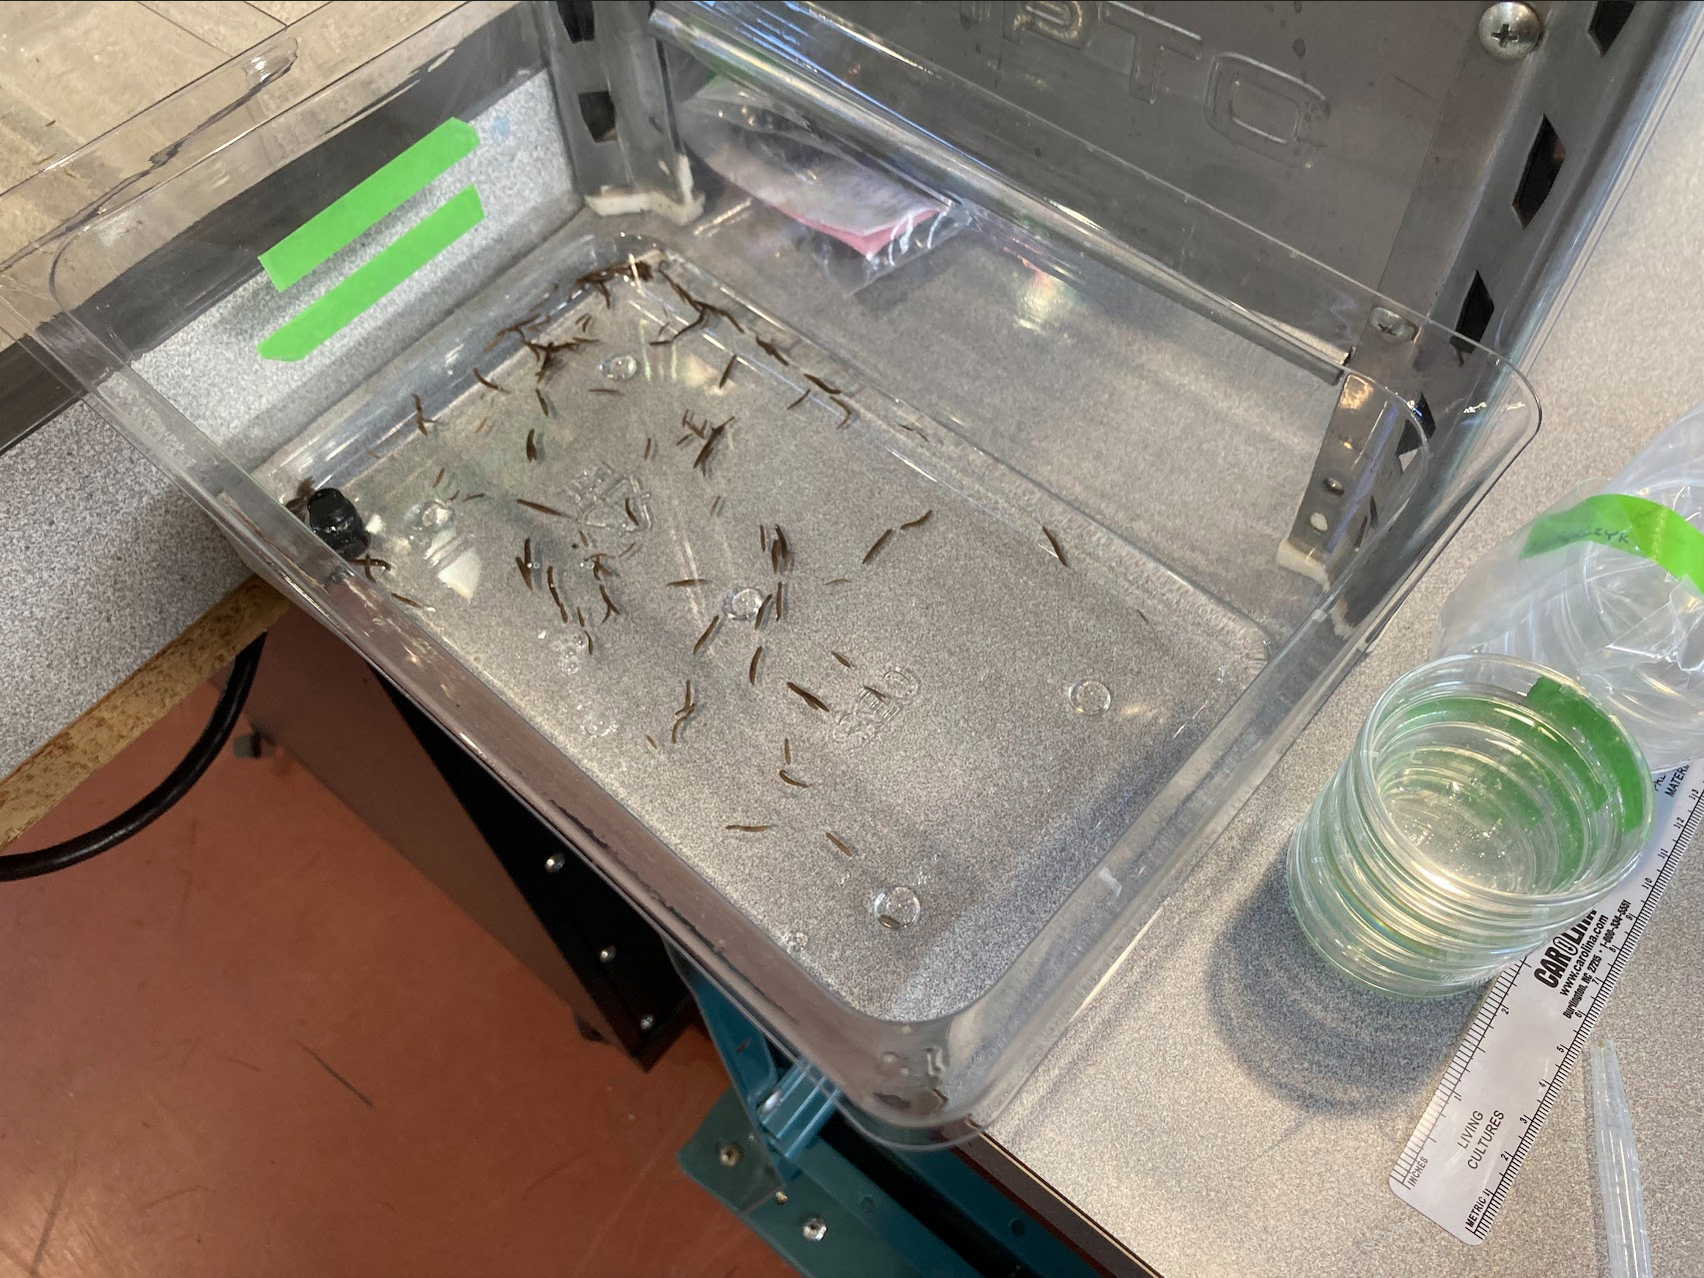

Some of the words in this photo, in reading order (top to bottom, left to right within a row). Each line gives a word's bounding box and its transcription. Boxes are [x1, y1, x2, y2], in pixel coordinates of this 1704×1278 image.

[1559, 914, 1609, 997] www.carolina.com
[1580, 972, 1593, 985] NC
[1457, 1110, 1484, 1150] LIVING
[1467, 1109, 1505, 1170] CULTURES
[1407, 1156, 1429, 1187] INCHES
[1465, 1196, 1486, 1228] METRIC
